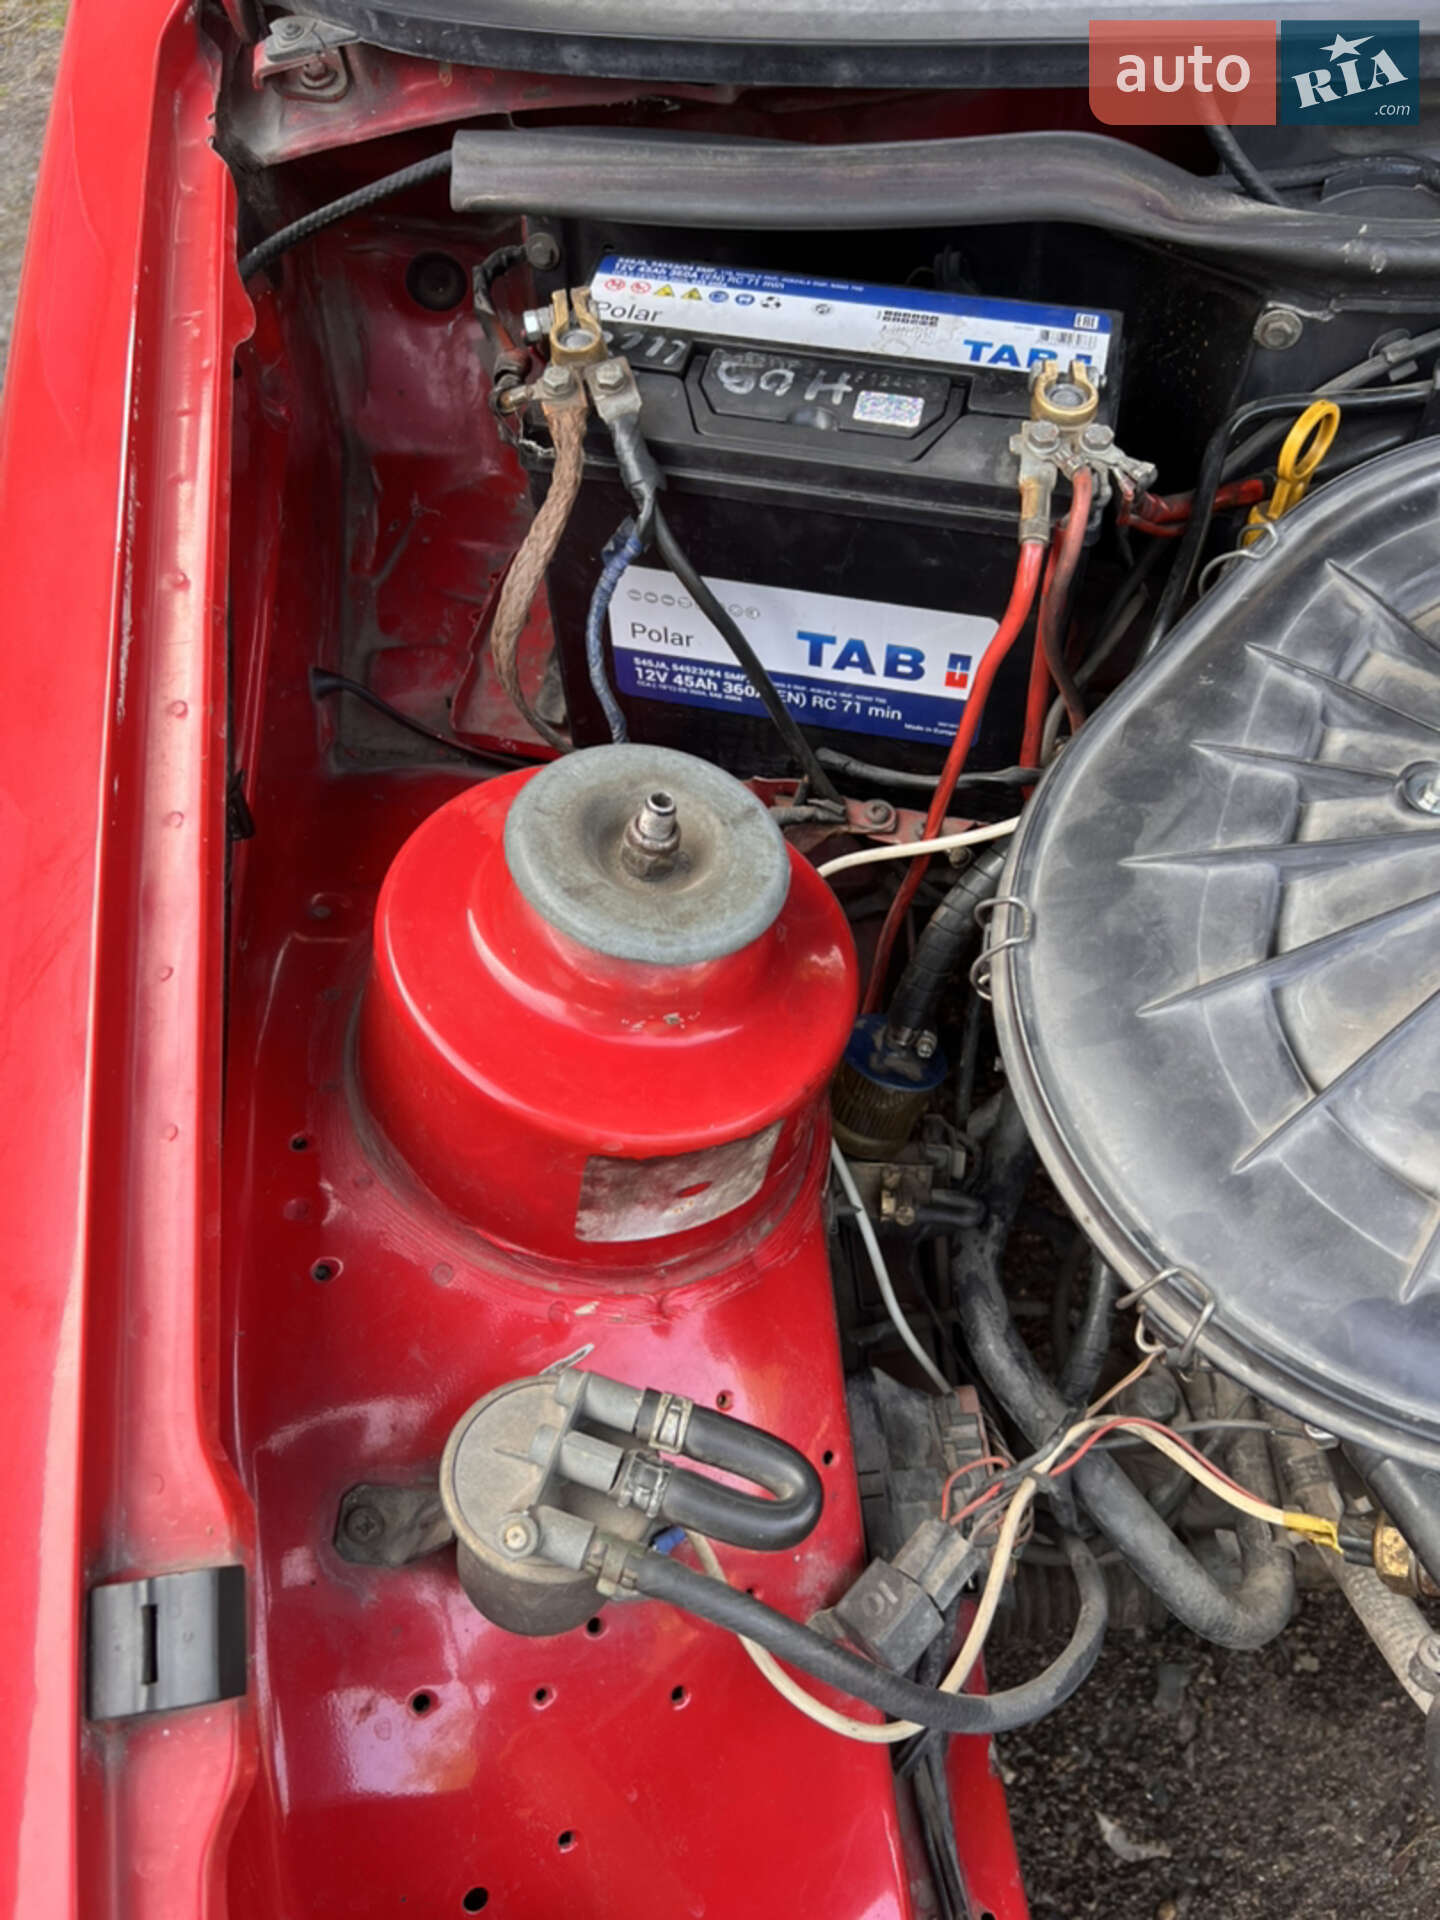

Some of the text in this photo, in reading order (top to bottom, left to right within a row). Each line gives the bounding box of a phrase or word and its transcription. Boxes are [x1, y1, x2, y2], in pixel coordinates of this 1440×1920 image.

[631, 622, 695, 647] Polar
[796, 630, 926, 681] TAB
[635, 667, 668, 683] 12V
[673, 673, 718, 691] 45Ah
[812, 695, 837, 711] RC
[842, 700, 861, 714] 71
[868, 705, 902, 721] min
